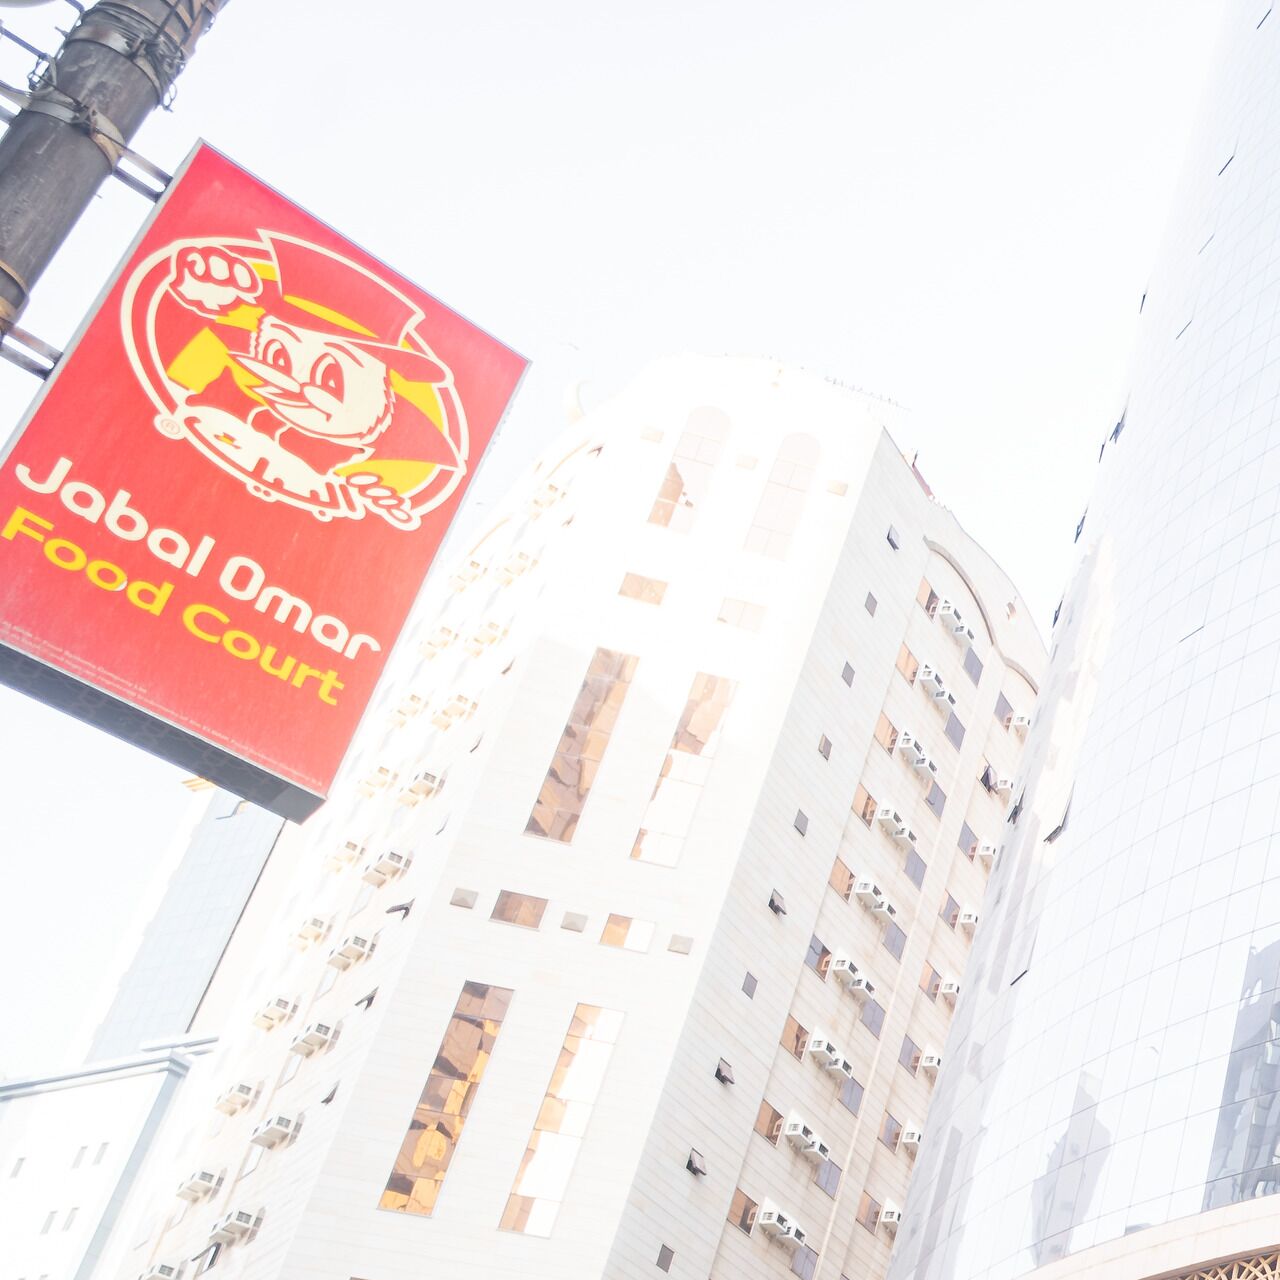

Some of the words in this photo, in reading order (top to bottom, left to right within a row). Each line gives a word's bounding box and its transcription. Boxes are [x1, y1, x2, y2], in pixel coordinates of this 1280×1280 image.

[1, 506, 174, 617] Food
[182, 604, 345, 706] Court
[15, 457, 216, 577] Jabal
[219, 556, 381, 660] Omar
